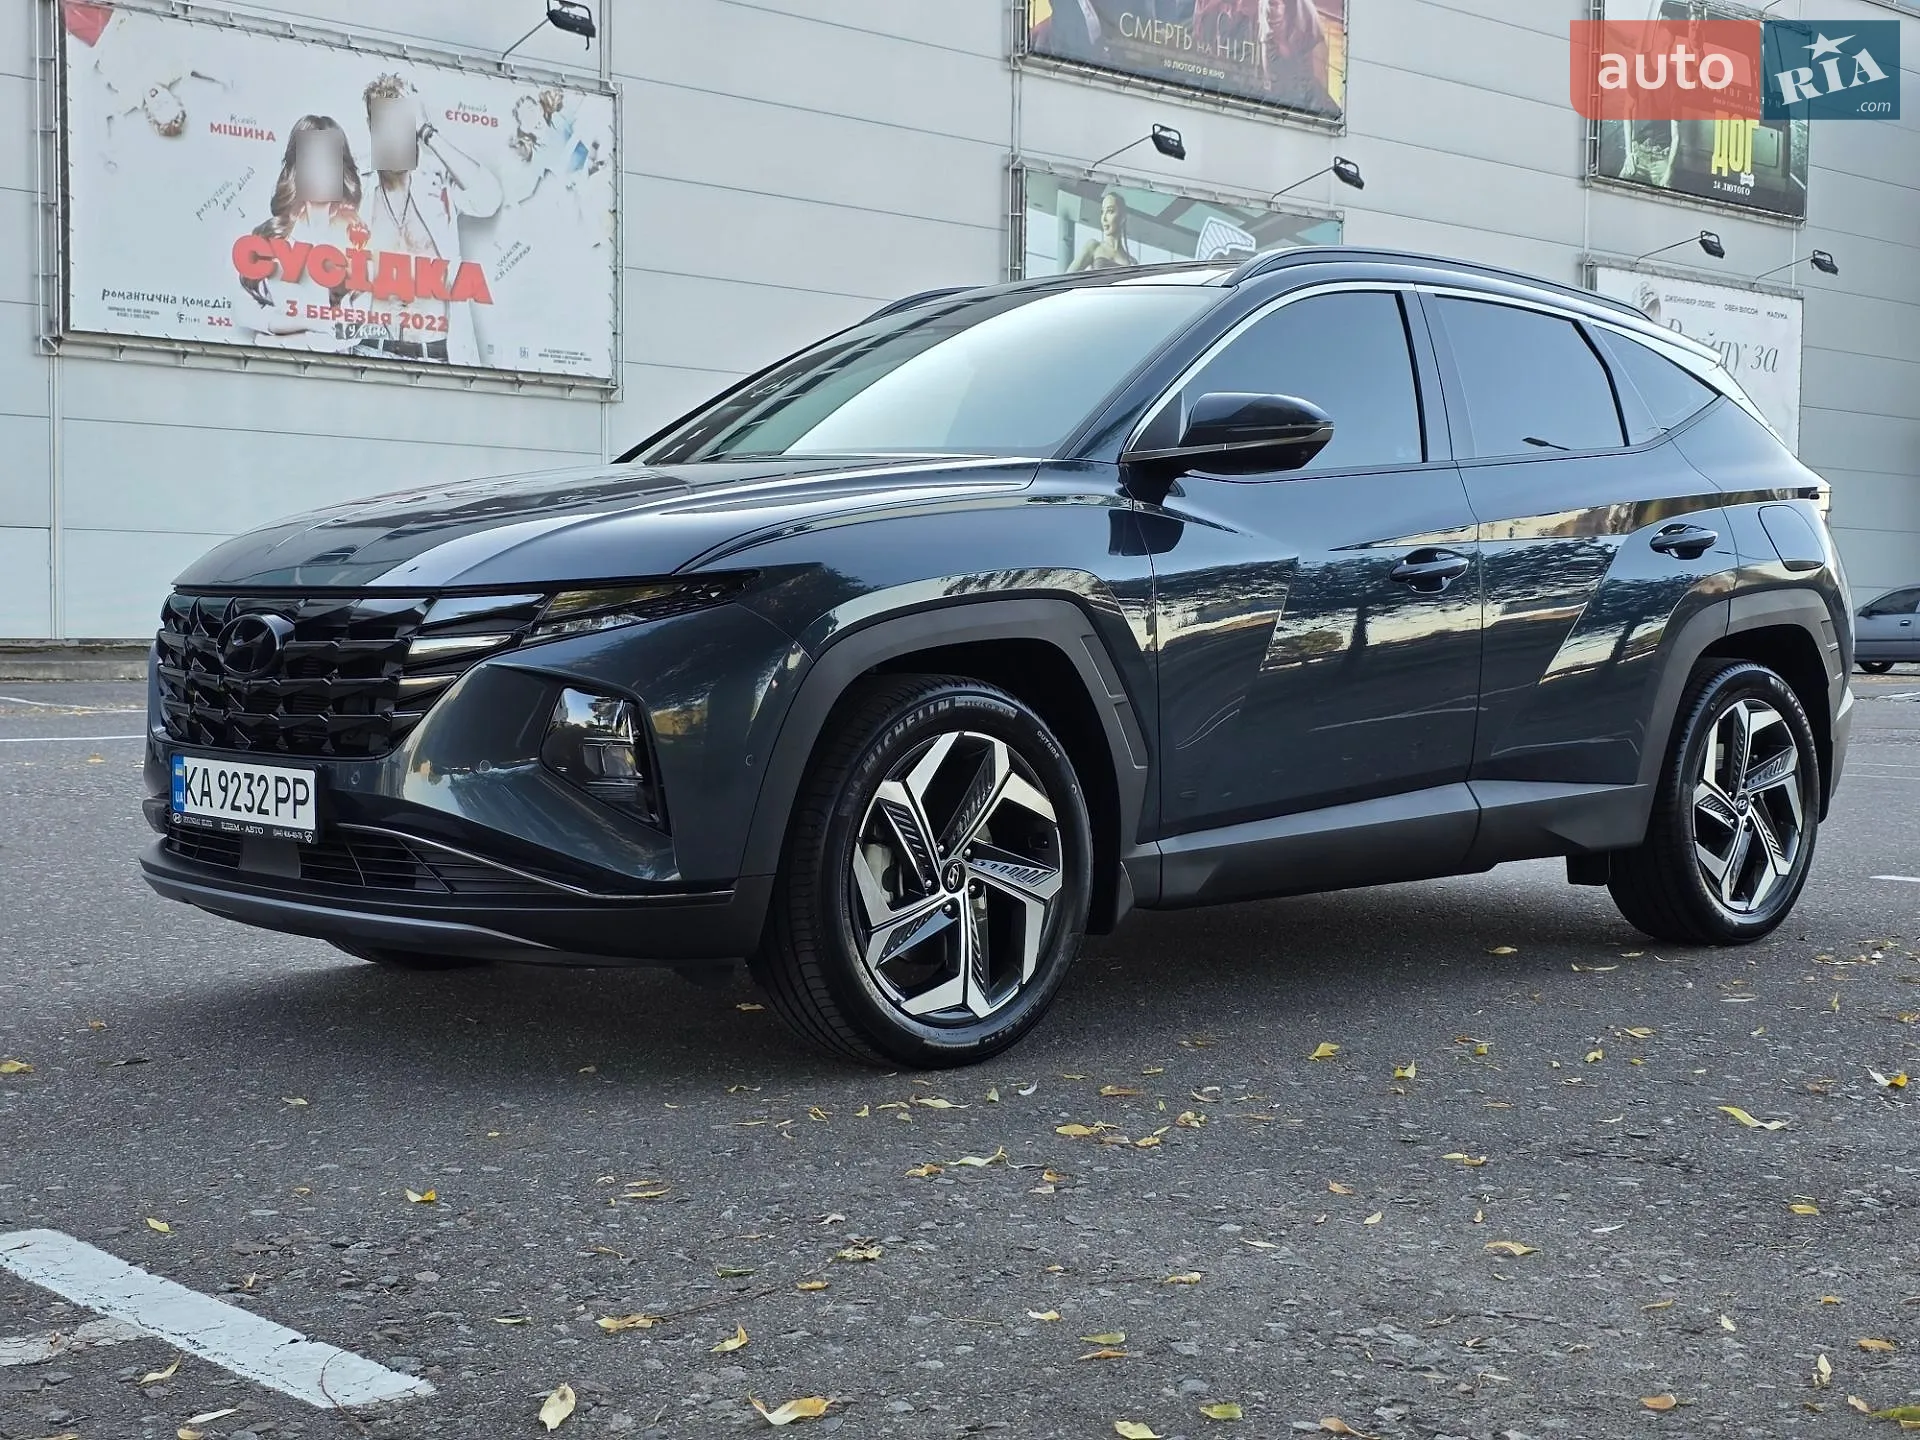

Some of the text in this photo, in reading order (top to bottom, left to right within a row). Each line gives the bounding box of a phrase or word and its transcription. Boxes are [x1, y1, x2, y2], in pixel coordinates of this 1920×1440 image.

[1120, 12, 1192, 50] СМЕРТЬ
[1172, 60, 1201, 75] ЛЮТОГО
[445, 109, 498, 127] ЄГОРОВ
[210, 121, 276, 142] МІШИНА
[232, 234, 494, 306] СУСІДКА
[101, 288, 177, 304] романтична
[286, 300, 448, 332] 3 БЕРЕЗНЯ 2022
